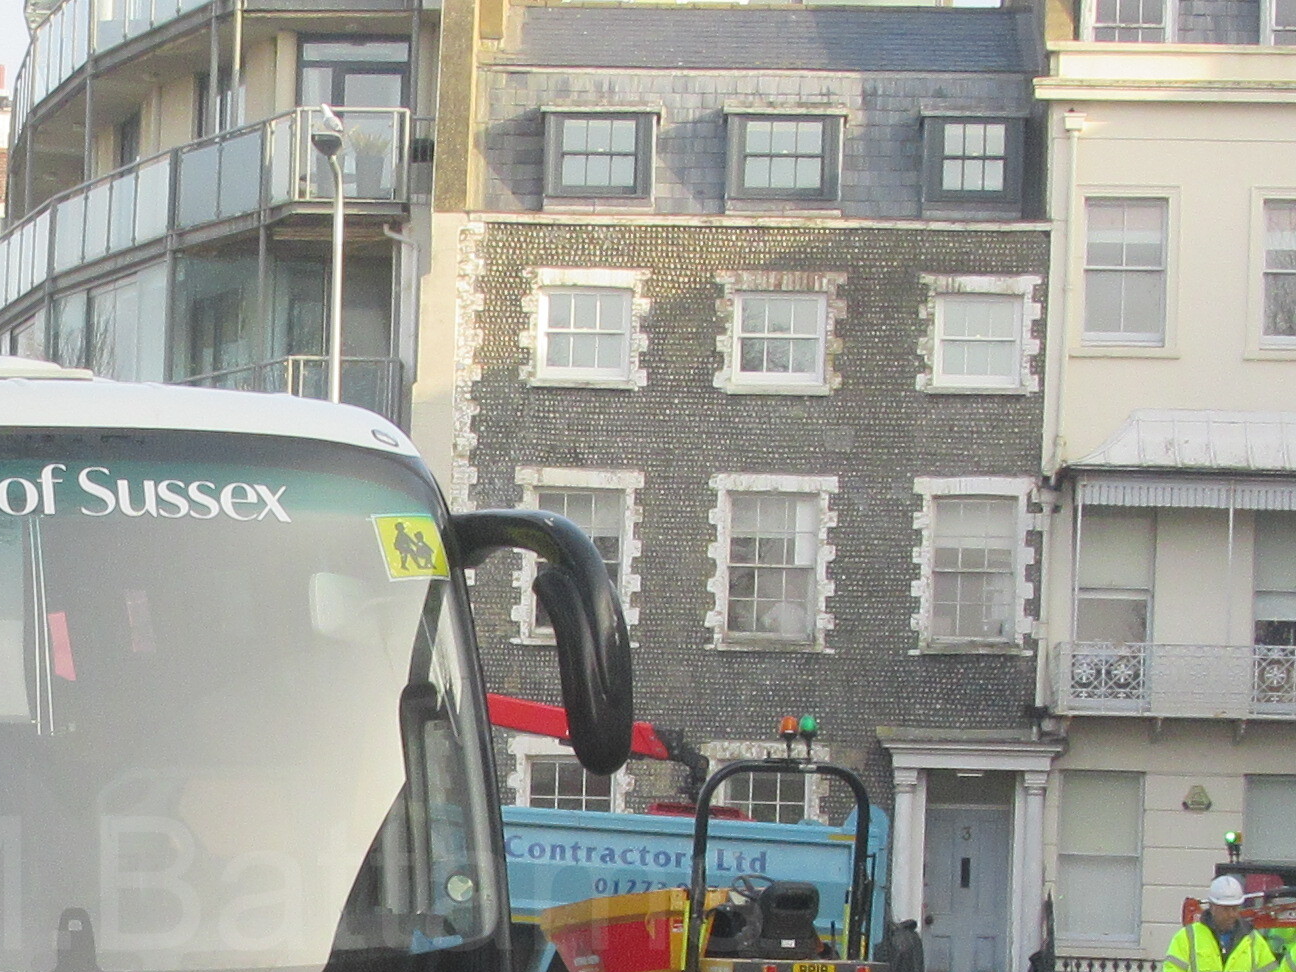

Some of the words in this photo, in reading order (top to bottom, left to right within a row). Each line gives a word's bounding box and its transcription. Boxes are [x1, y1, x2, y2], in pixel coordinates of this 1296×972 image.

[78, 466, 292, 523] Sussex
[504, 834, 698, 869] Contractor
[716, 848, 767, 874] Ltd
